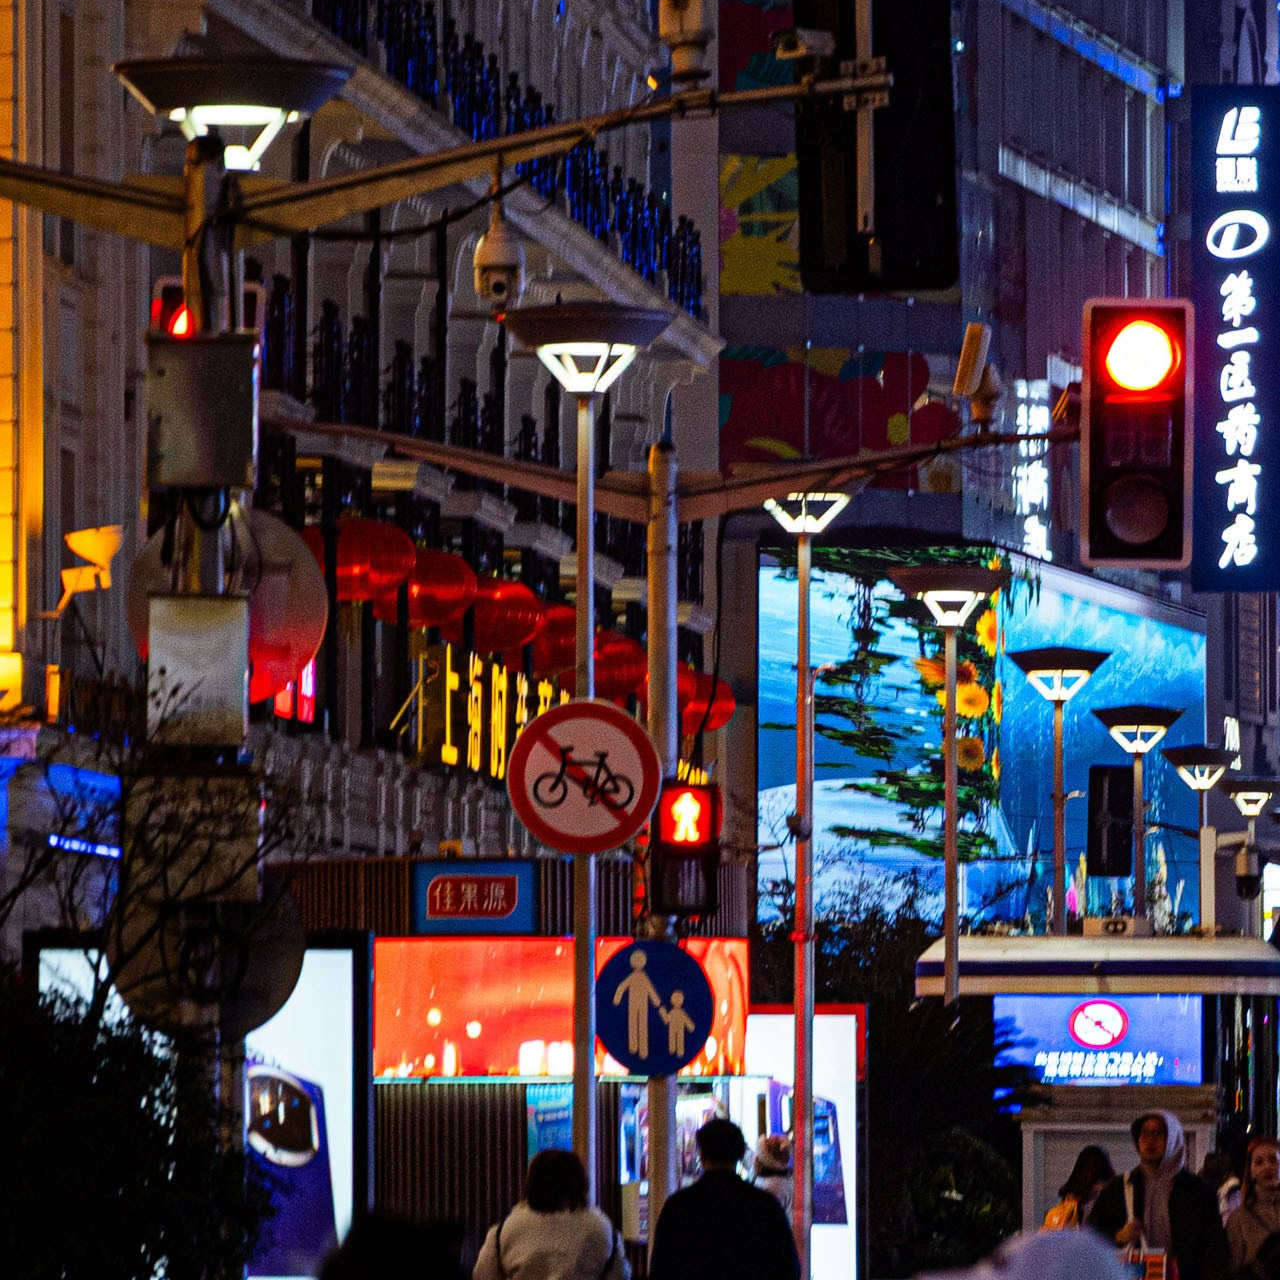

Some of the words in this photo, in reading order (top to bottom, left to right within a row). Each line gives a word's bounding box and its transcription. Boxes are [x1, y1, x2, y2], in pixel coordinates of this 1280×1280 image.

[1215, 270, 1262, 569] 第一医药商店
[434, 881, 507, 912] 佳果源
